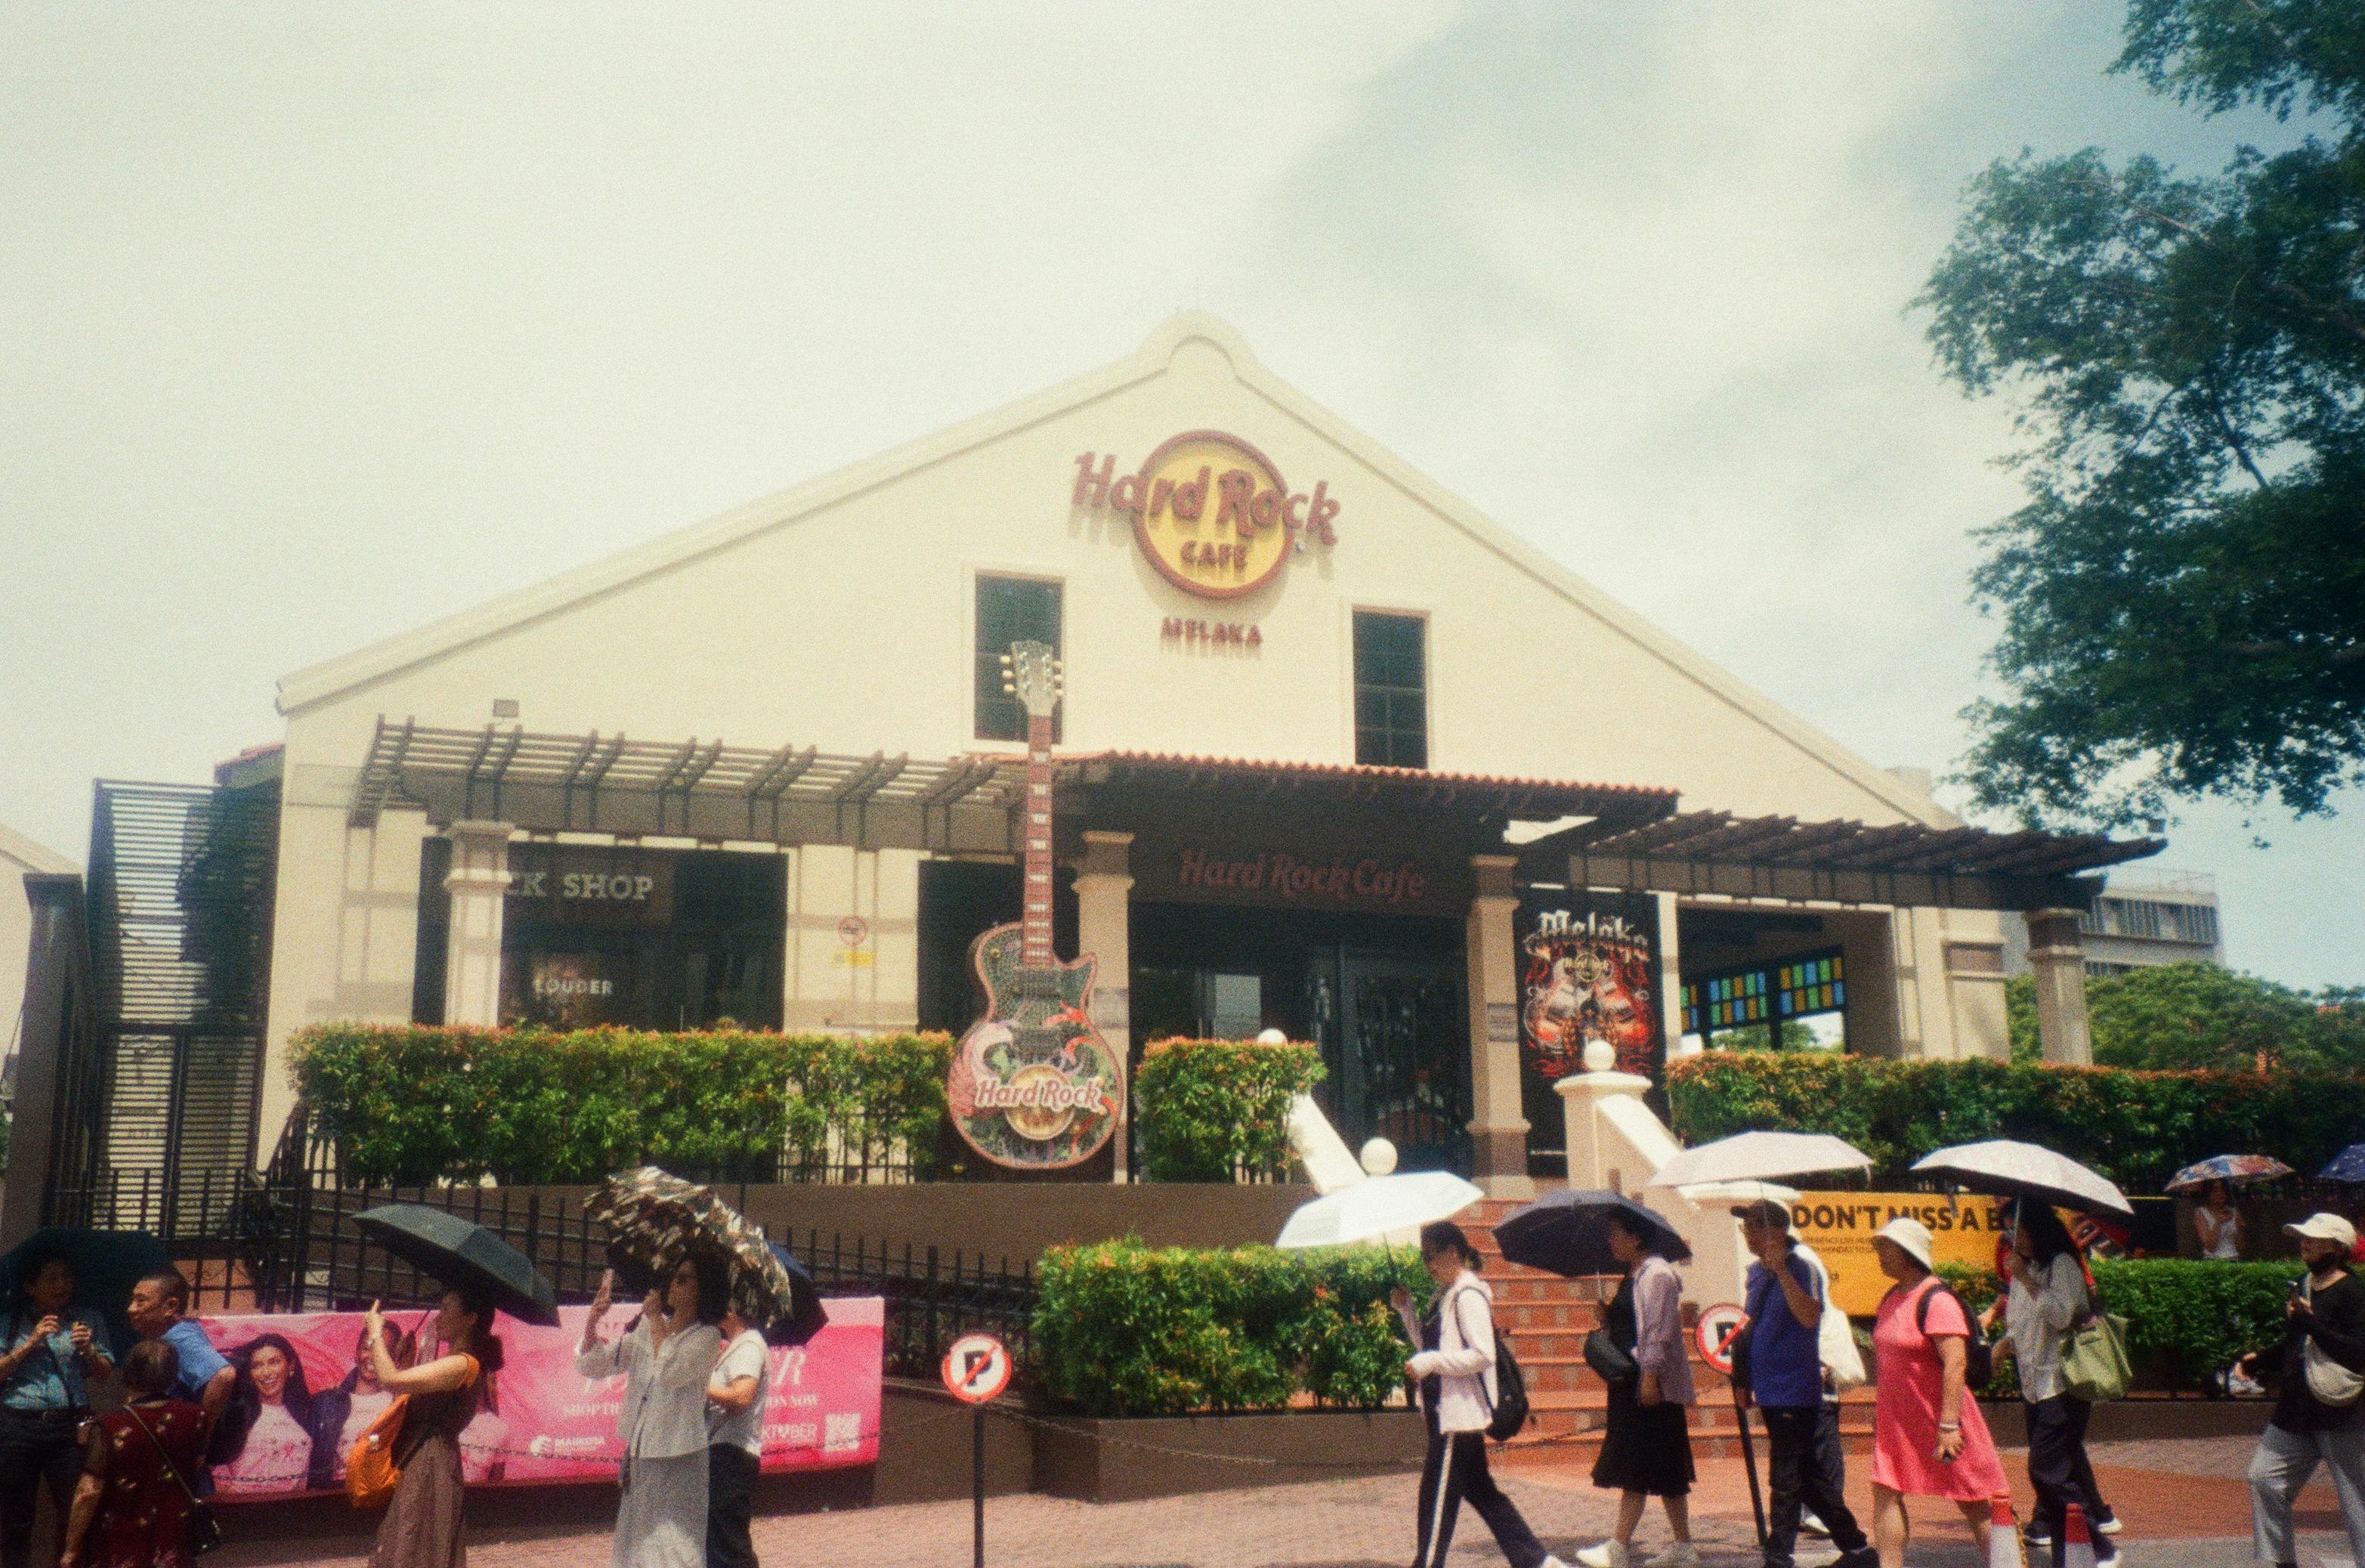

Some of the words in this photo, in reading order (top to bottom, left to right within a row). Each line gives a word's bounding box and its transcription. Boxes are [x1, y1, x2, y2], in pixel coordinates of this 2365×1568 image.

[1071, 452, 1210, 521] Hard
[1217, 469, 1340, 547] Rock
[1180, 540, 1248, 571] CAFE
[1161, 617, 1262, 648] MELAKA
[563, 873, 653, 900] SHOP
[1179, 847, 1267, 889] Hard
[1270, 853, 1350, 900] Rock
[1353, 858, 1427, 904] Cafe
[977, 1079, 1040, 1106] Hard
[1042, 1079, 1101, 1112] Rock
[1792, 1205, 1881, 1229] DON'T
[1961, 1208, 1979, 1231] A
